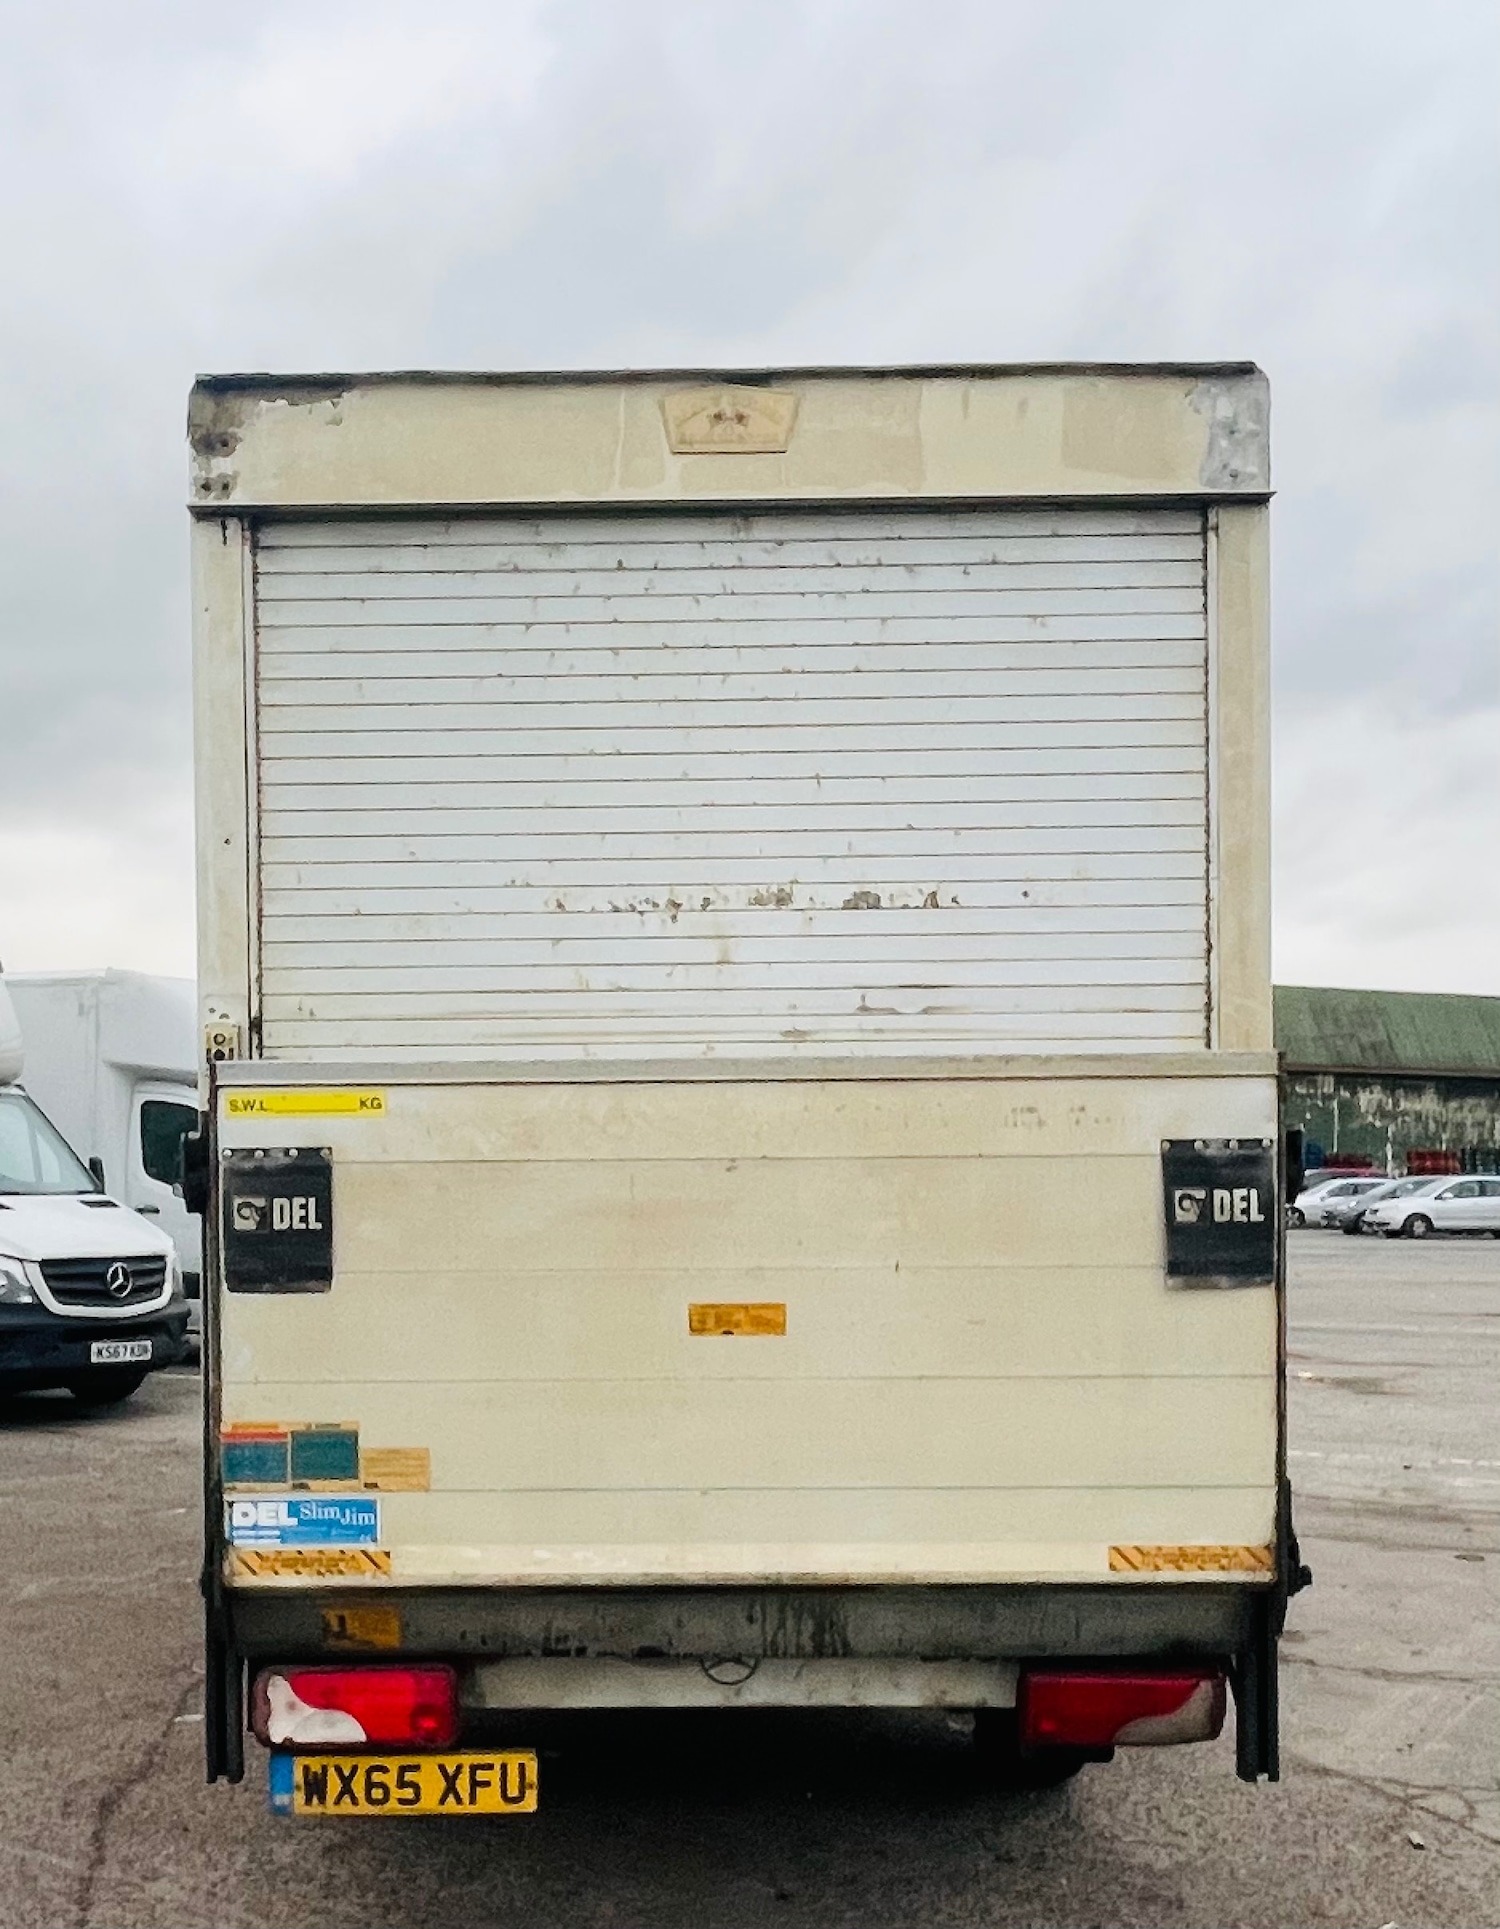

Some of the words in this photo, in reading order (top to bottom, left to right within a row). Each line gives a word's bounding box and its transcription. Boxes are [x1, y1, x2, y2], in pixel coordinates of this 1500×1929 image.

[359, 1097, 383, 1110] KG
[273, 1196, 322, 1230] DEL
[1213, 1188, 1265, 1222] DEL
[232, 1501, 298, 1527] DEL
[302, 1763, 422, 1805] WX65
[437, 1762, 527, 1805] XFU
